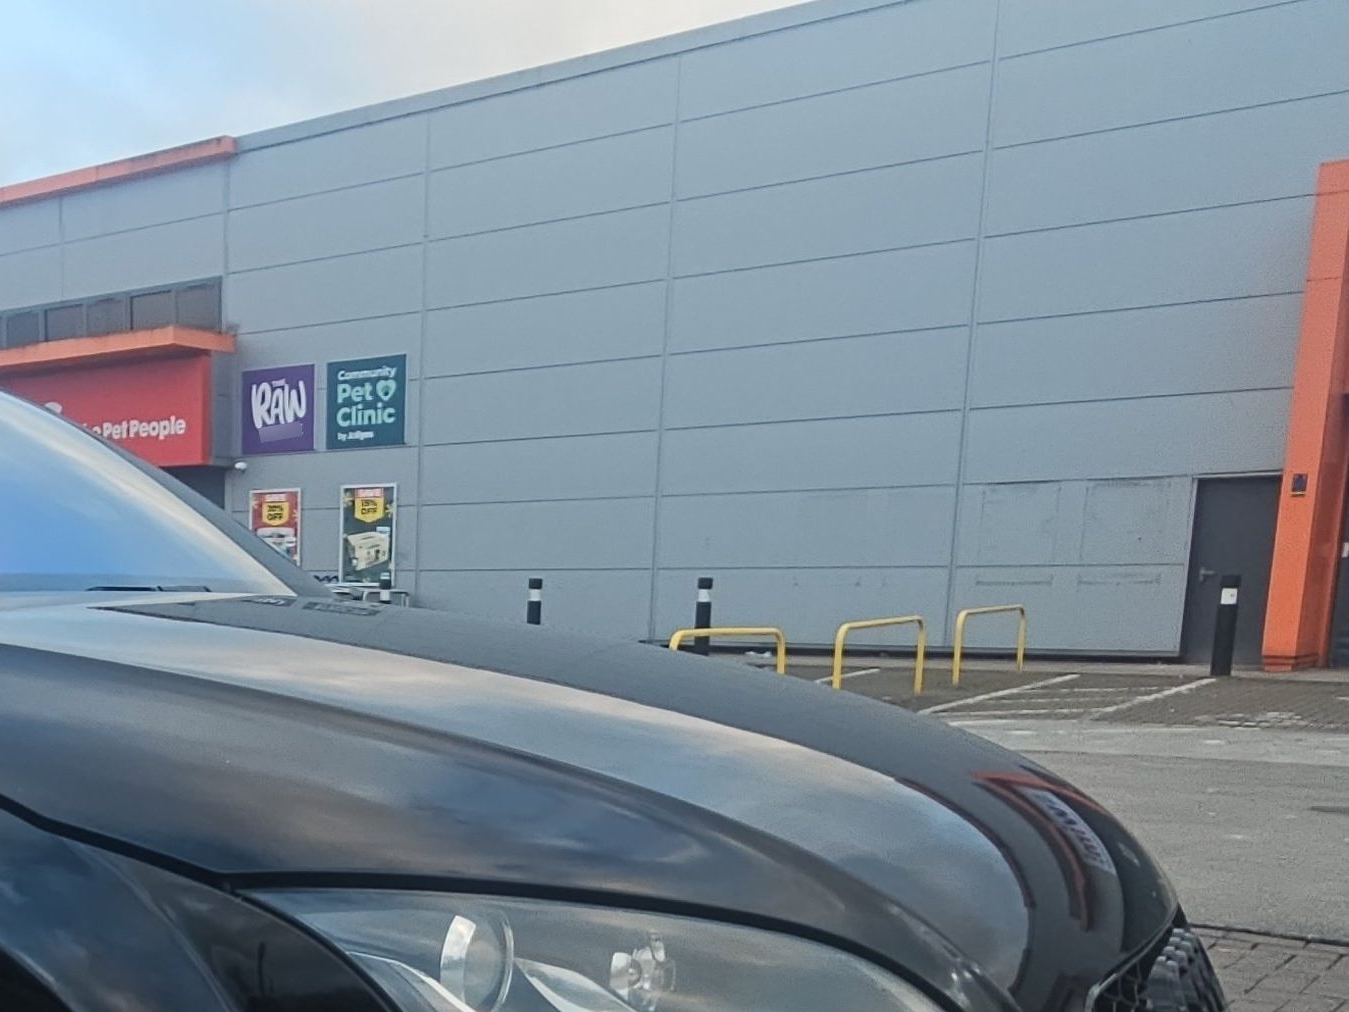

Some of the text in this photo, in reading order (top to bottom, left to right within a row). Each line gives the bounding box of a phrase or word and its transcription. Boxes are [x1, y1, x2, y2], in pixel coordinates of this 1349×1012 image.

[251, 380, 307, 429] RAW
[337, 382, 374, 404] Pet
[336, 402, 396, 427] Clinic
[102, 420, 129, 439] Pet
[128, 415, 187, 440] People
